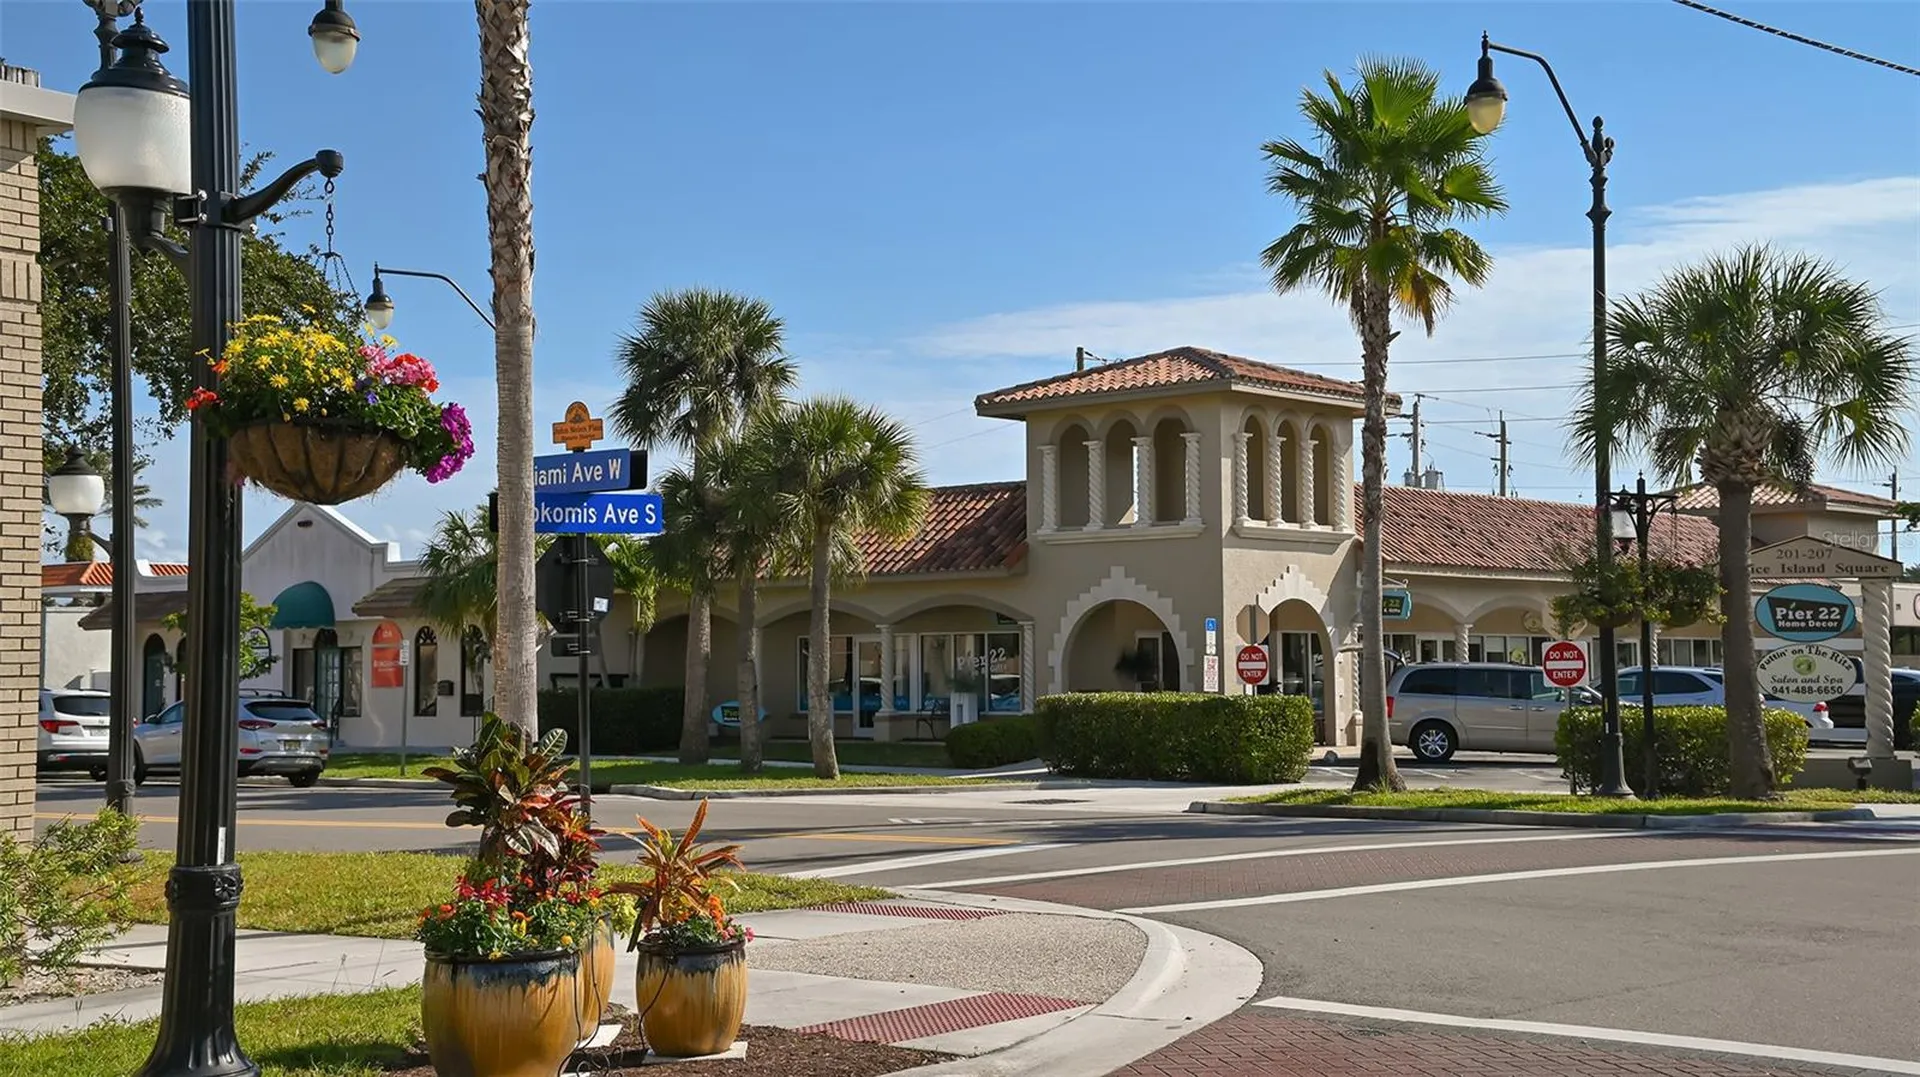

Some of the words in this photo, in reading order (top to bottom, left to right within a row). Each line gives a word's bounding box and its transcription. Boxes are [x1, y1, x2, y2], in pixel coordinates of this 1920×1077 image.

[534, 463, 566, 485] iami
[572, 462, 603, 483] Ave
[608, 458, 621, 480] W
[534, 502, 597, 524] okomis
[604, 503, 638, 524] Ave
[645, 503, 656, 524] S
[1776, 549, 1833, 560] 201-207
[1751, 564, 1770, 574] ice
[1781, 563, 1825, 574] Island
[1835, 562, 1888, 576] Square
[1776, 603, 1814, 620] Pier
[1819, 607, 1841, 620] 22
[989, 647, 1007, 663] 22
[1549, 651, 1561, 659] DO
[1563, 650, 1578, 659] NOT
[1805, 645, 1828, 657] The
[1829, 651, 1852, 671] Ritz
[1553, 671, 1578, 679] ENTER
[1770, 675, 1799, 684] Salon
[1800, 675, 1820, 684] and
[1822, 675, 1843, 685] Spa
[1771, 685, 1843, 695] 941-488-6650
